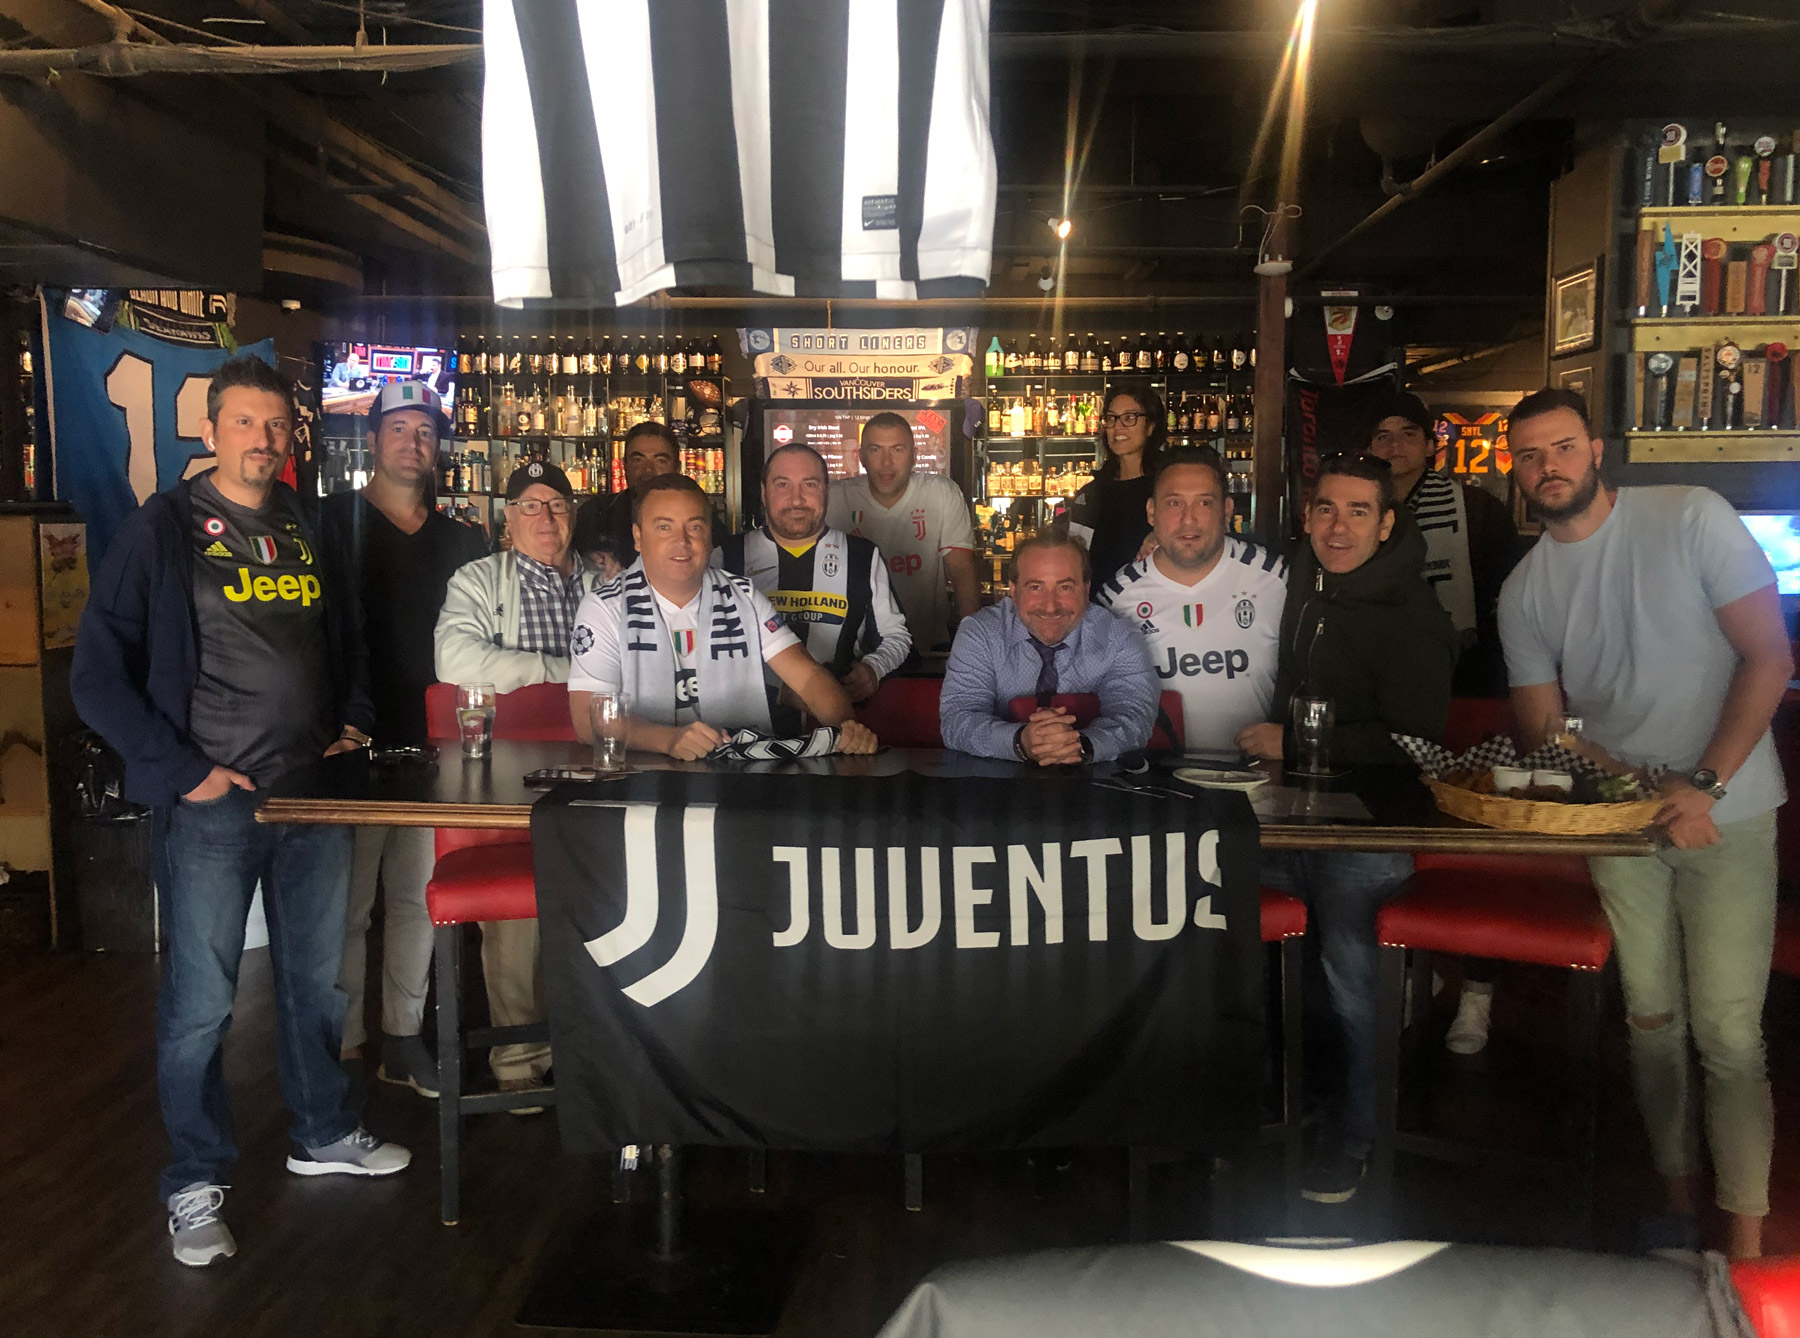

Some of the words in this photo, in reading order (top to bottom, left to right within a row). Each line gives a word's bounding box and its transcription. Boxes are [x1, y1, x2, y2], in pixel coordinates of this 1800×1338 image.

[791, 333, 849, 350] SHORT
[859, 333, 927, 350] LINERS
[804, 361, 825, 373] Our
[829, 361, 845, 374] all.
[849, 361, 870, 373] Our
[873, 361, 921, 374] honour.
[839, 379, 886, 388] VANCOUVER
[814, 387, 913, 400] SOUTHSIDERS
[1453, 438, 1491, 474] 12
[889, 553, 923, 577] ep
[223, 567, 321, 606] Jeep
[768, 595, 788, 607] EW
[790, 596, 848, 610] HOLLAND
[791, 611, 824, 622] GROUP
[1154, 646, 1249, 680] Jeep
